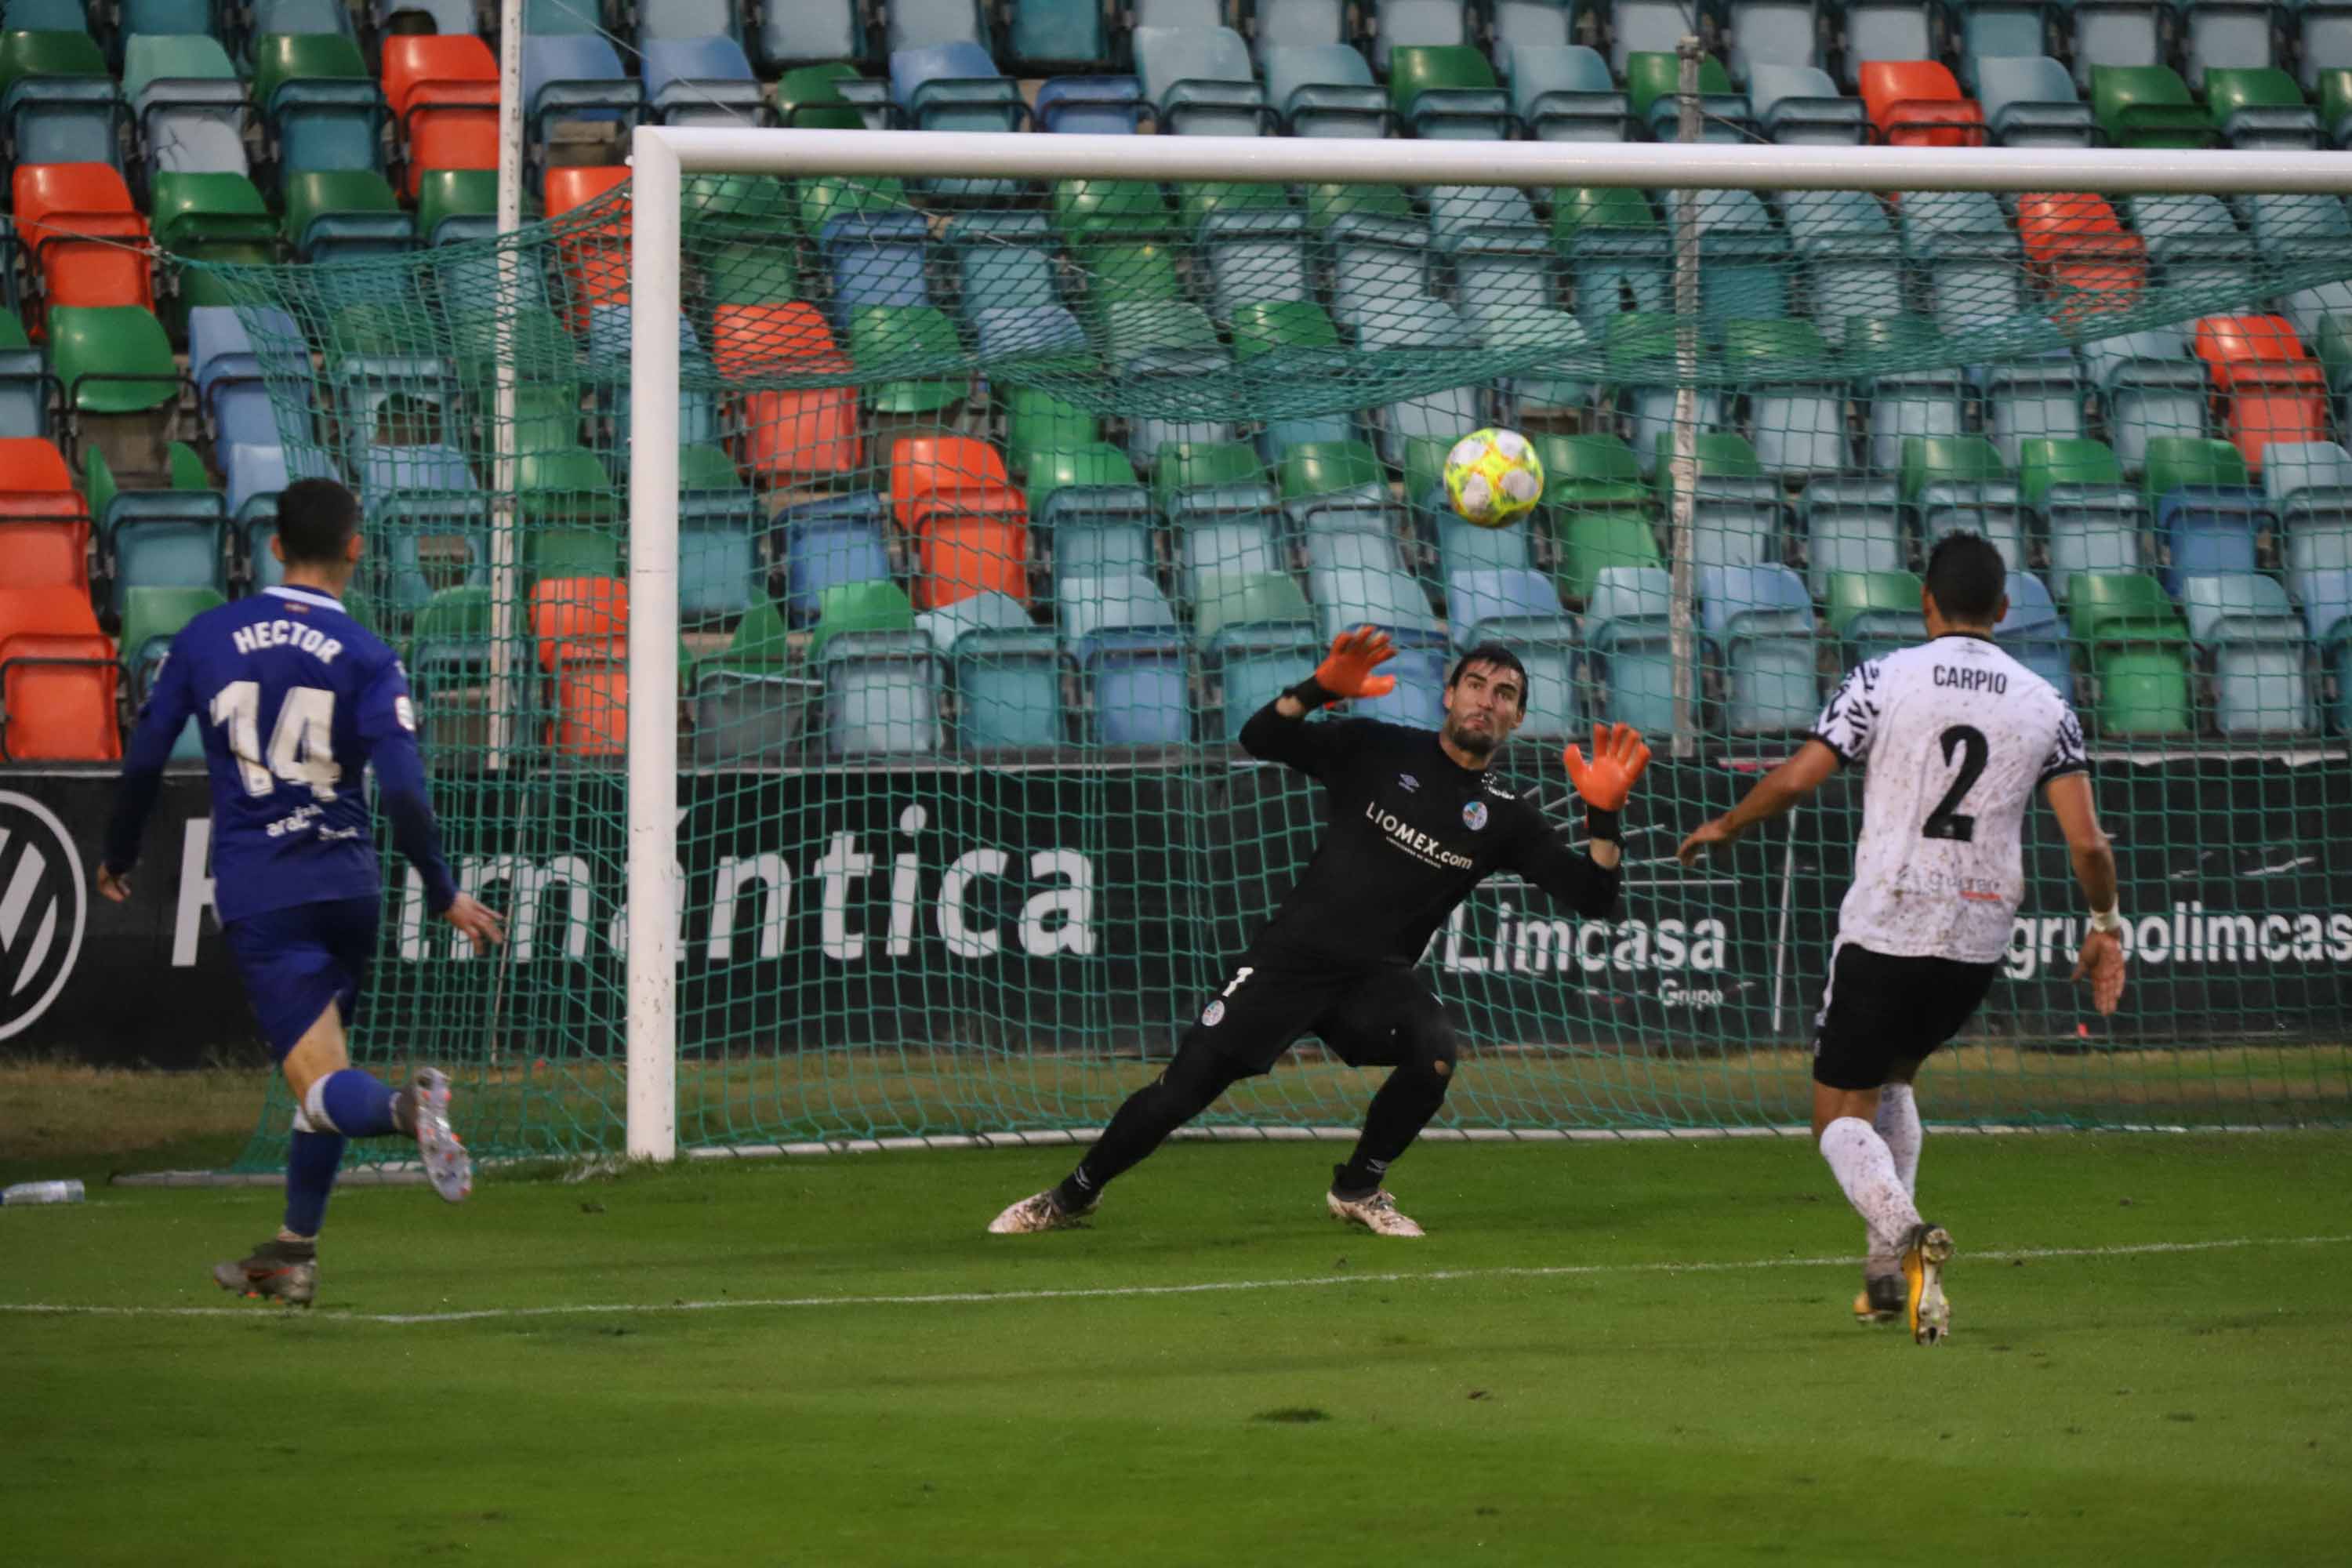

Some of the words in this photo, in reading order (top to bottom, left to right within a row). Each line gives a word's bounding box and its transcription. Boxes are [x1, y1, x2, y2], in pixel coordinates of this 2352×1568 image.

[232, 619, 343, 664] HECTOR
[1933, 664, 2007, 695] CARPIO
[209, 680, 343, 803] 14
[1923, 724, 1989, 843] 2
[1365, 801, 1473, 870] LIOMEX.com
[1444, 901, 1726, 973] Limcasa
[1657, 978, 1725, 1011] Grupo
